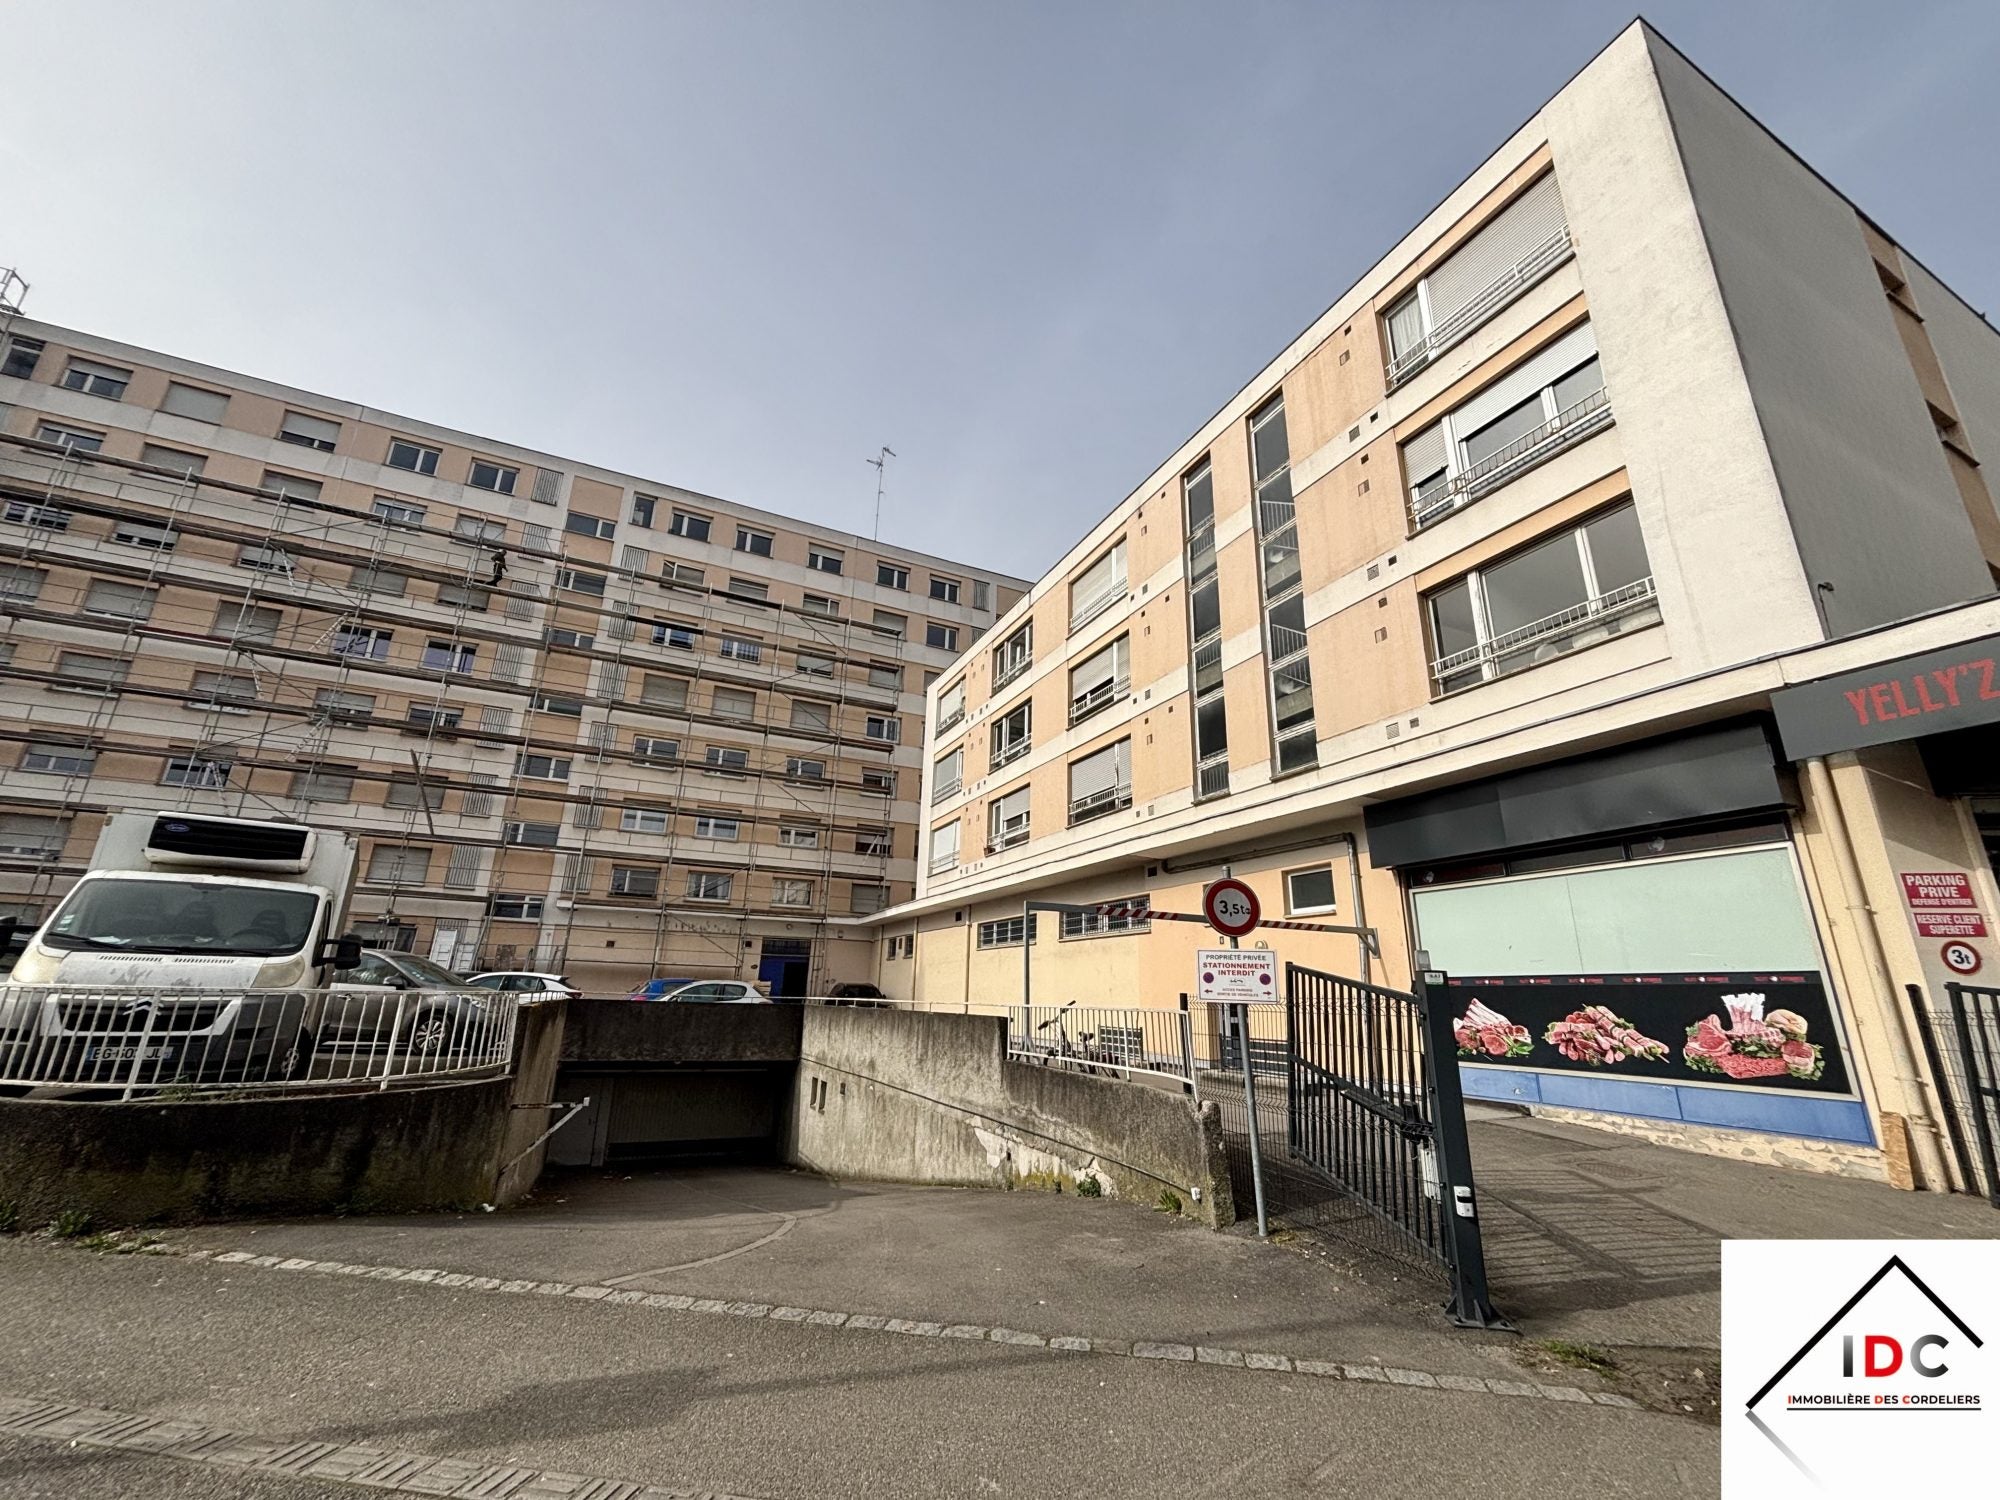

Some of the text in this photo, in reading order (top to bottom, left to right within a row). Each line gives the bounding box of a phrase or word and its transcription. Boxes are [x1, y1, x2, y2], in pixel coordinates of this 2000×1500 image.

[1843, 658, 2000, 726] YELLY'Z
[1905, 874, 1966, 886] PARKING
[1918, 886, 1960, 898] PRIVE
[1911, 898, 1941, 906] DEFENSE
[1916, 914, 1982, 925] RESERVE CLIENT
[1929, 925, 1976, 935] SUPERETTE
[1205, 953, 1267, 962] PROPRIÉTÉ PRIVÉE
[1951, 949, 1971, 965] 3t
[1202, 961, 1271, 970] STATIONNEMENT
[1217, 969, 1256, 977] INTERDIT
